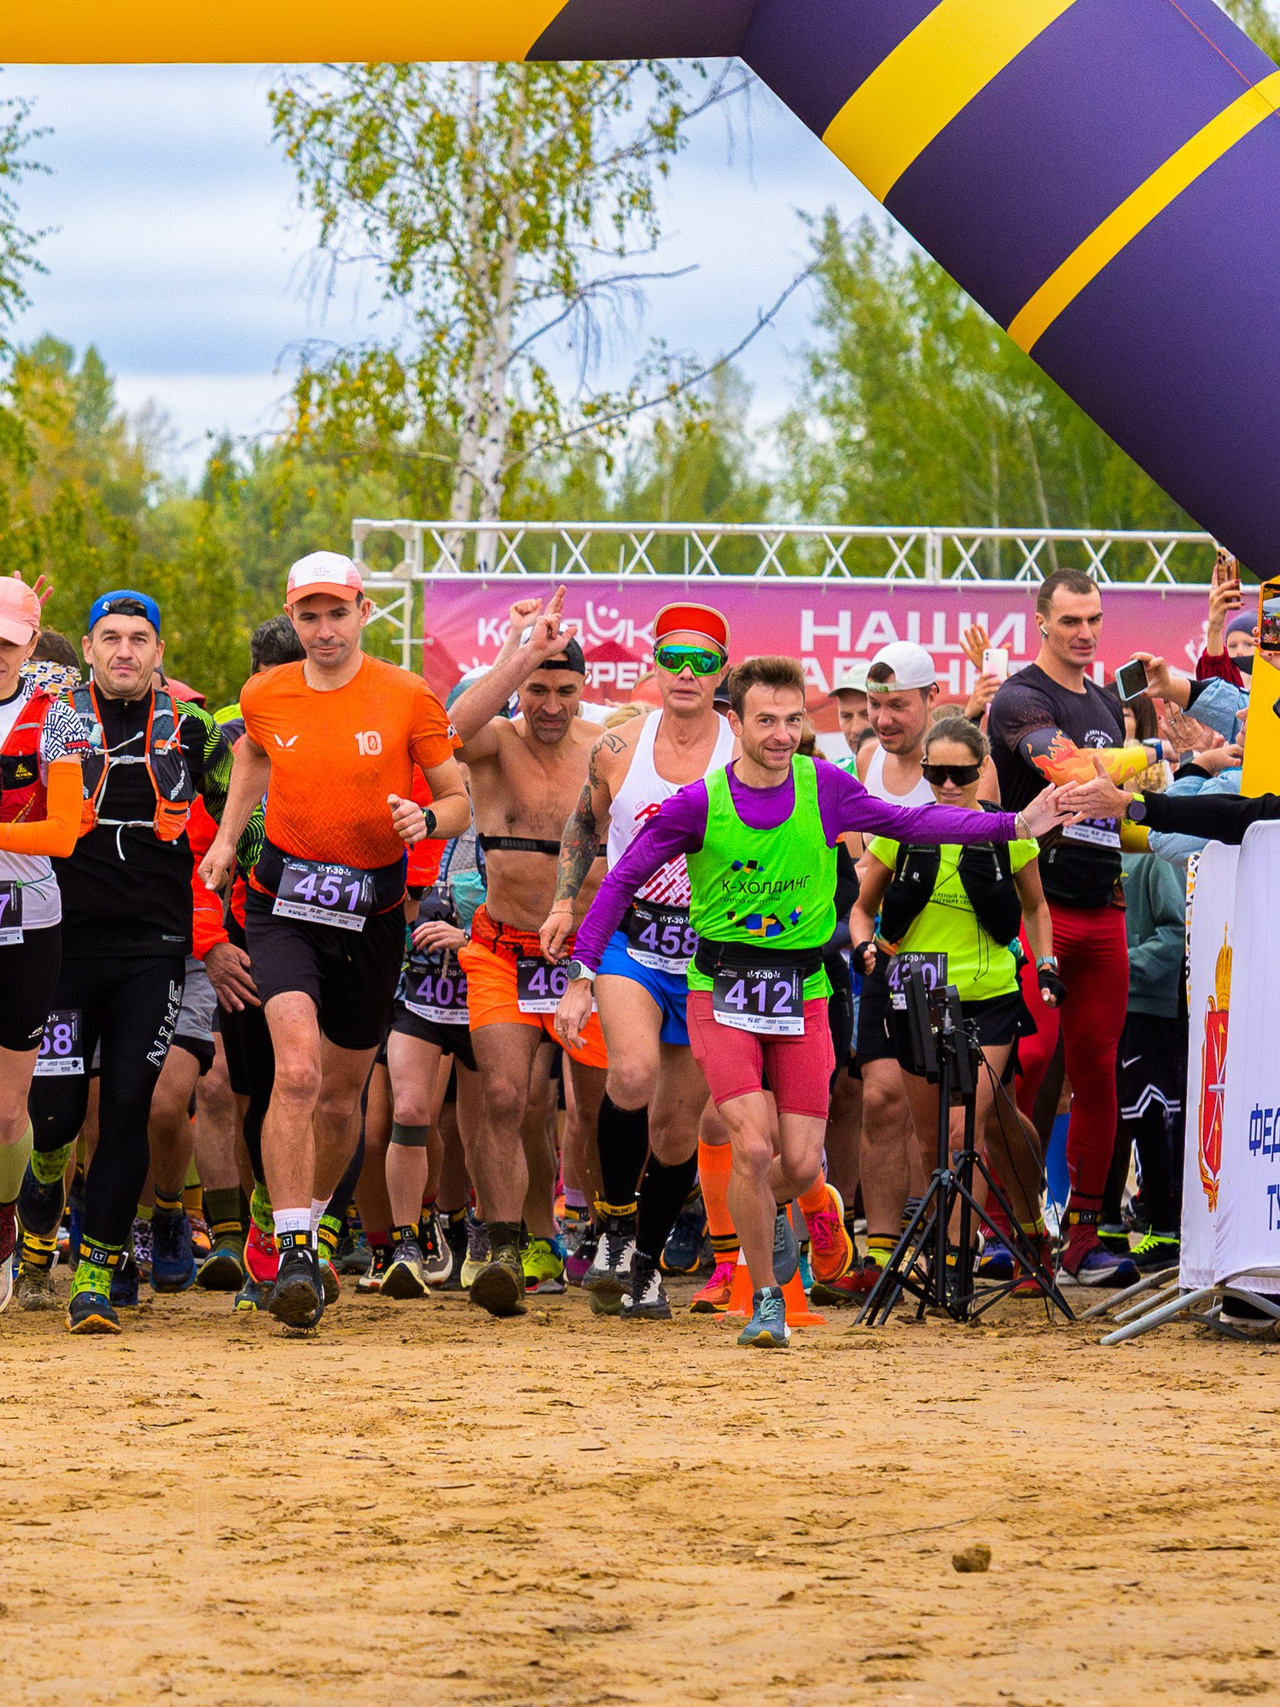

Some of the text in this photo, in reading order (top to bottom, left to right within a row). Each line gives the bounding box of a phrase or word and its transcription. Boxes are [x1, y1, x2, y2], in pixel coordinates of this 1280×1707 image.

[801, 609, 1026, 654] НАШИ
[354, 730, 383, 756] 10
[293, 872, 361, 912] 451
[721, 875, 811, 895] К-ХОЛДИНГ
[638, 922, 700, 956] 458
[527, 966, 569, 997] 46
[724, 979, 792, 1014] 412
[94, 1252, 104, 1260] LT
